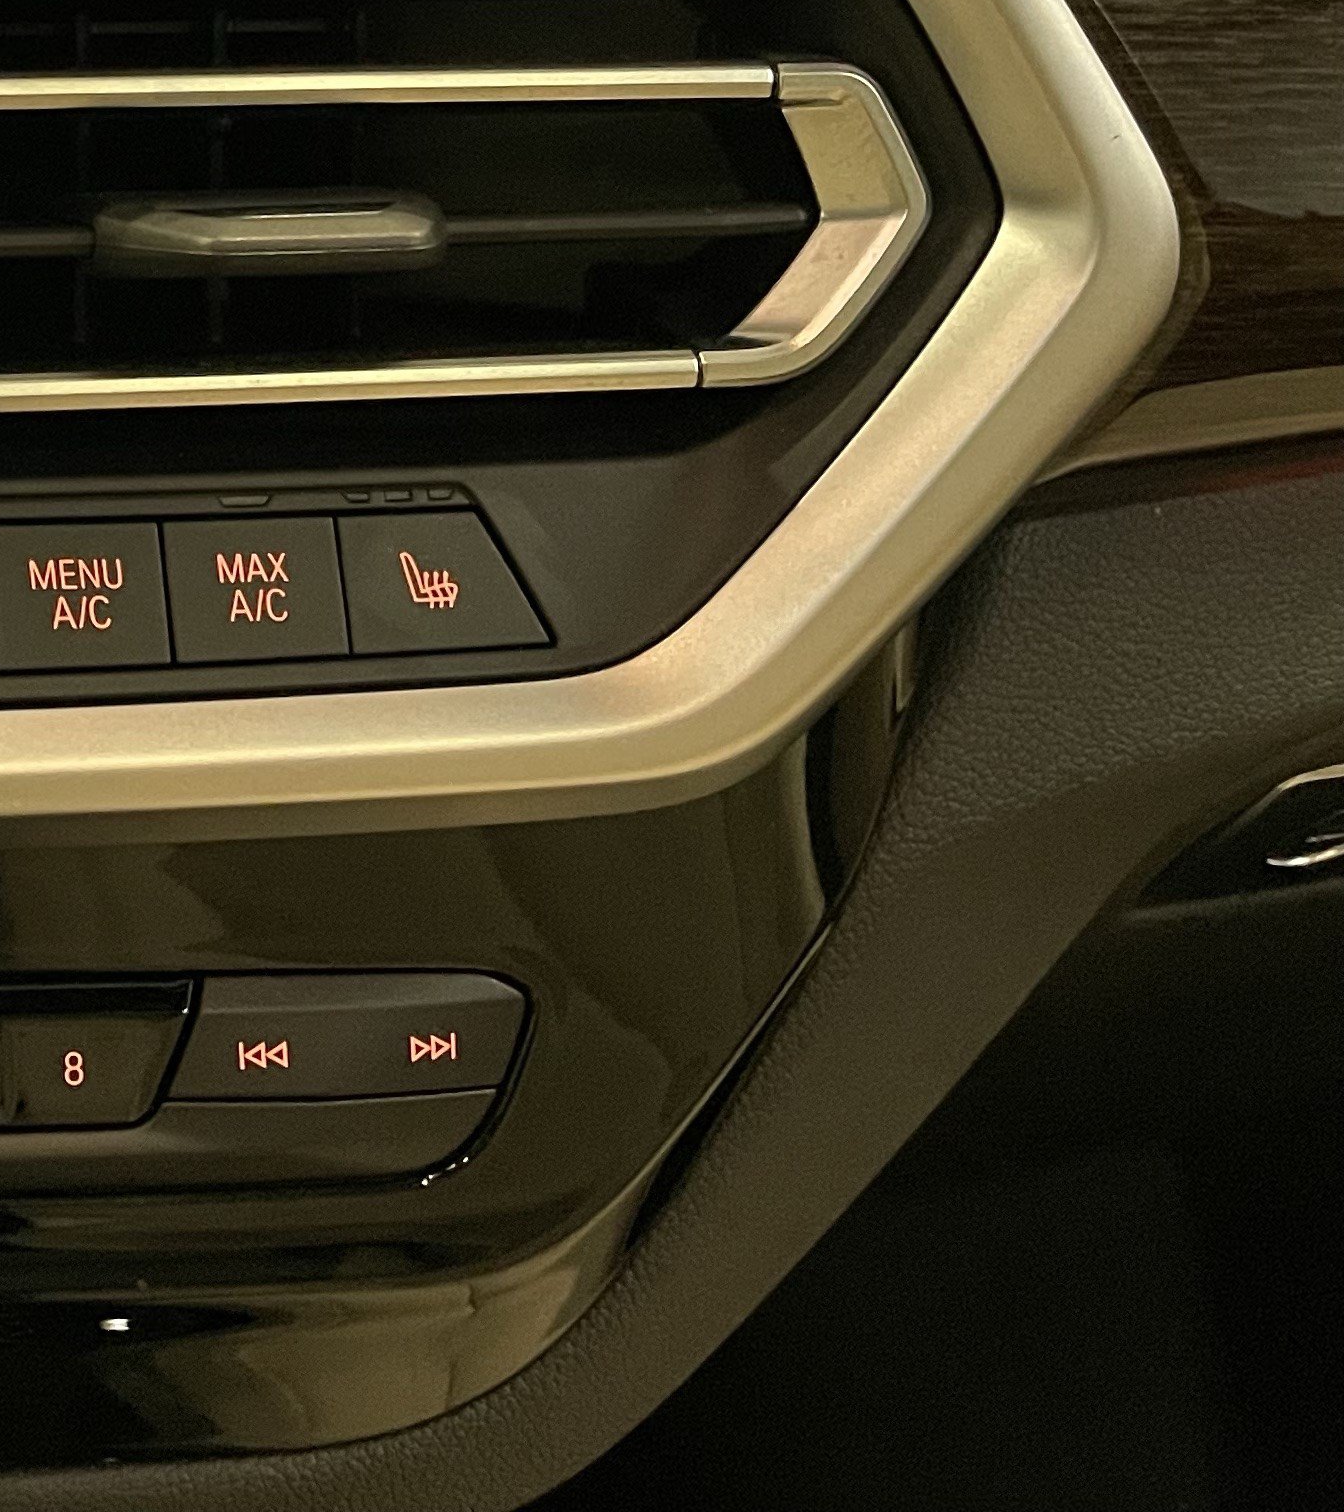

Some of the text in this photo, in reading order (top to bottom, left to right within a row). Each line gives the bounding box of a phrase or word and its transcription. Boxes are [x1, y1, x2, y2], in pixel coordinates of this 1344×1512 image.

[27, 558, 124, 591] MENU
[215, 552, 290, 585] MAX
[52, 594, 112, 631] A/C
[229, 588, 289, 624] A/C
[63, 1050, 85, 1087] 8
